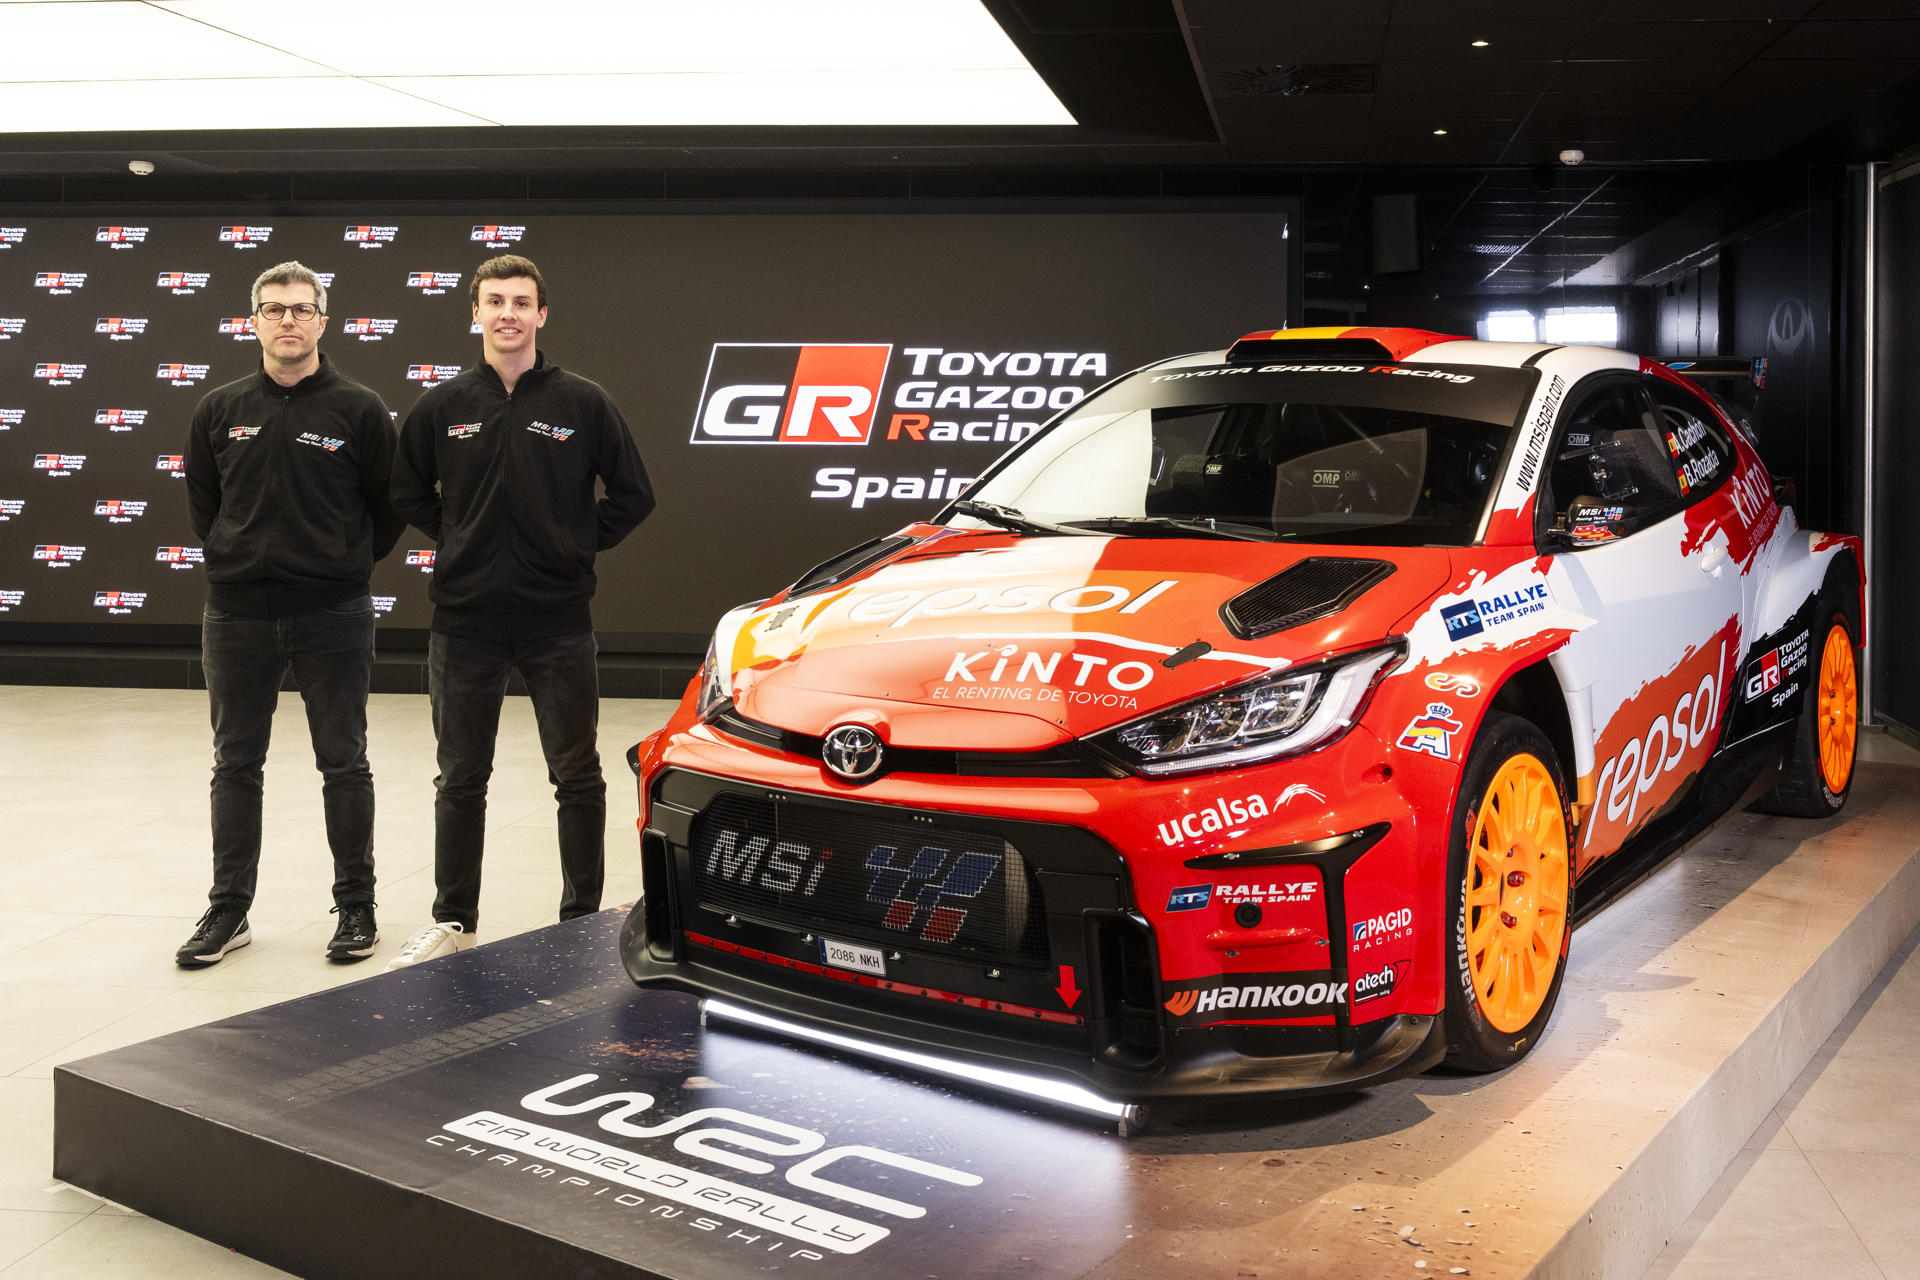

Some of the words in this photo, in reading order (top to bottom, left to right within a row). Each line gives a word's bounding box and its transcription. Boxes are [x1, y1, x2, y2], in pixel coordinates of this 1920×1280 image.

[97, 232, 119, 241] GR
[220, 231, 242, 241] GR
[345, 231, 368, 240] GR
[472, 230, 495, 240] GR
[36, 277, 58, 287] GR
[158, 277, 180, 287] GR
[408, 277, 431, 287] GR
[96, 323, 118, 332] GR
[220, 323, 242, 332] GR
[345, 323, 368, 333] GR
[903, 348, 1107, 377] TOYOTA
[35, 368, 57, 378] GR
[158, 369, 180, 378] GR
[408, 370, 430, 379] GR
[1149, 367, 1253, 383] TOYOTA
[1257, 365, 1365, 373] GAZOO
[1367, 366, 1475, 383] Racing
[894, 381, 1085, 410] GAZOO
[702, 384, 872, 438] GR
[96, 414, 118, 424] GR
[887, 414, 1041, 442] Racin
[1516, 374, 1566, 492] www.msispain.com
[1568, 435, 1590, 444] OMP
[35, 459, 56, 469] GR
[157, 460, 179, 470] GR
[1312, 472, 1340, 484] OMP
[96, 505, 118, 515] GR
[34, 550, 56, 560] GR
[157, 552, 179, 561] GR
[407, 555, 429, 565] GR
[95, 597, 117, 606] GR
[1478, 584, 1548, 616] RALLYE
[1444, 609, 1480, 632] RTS
[1485, 611, 1515, 627] TEAM
[1517, 602, 1545, 617] SPAIN
[1779, 628, 1809, 656] TOYOTA
[1780, 642, 1807, 668] GAZOO
[1781, 654, 1807, 680] Racing
[1747, 664, 1778, 699] GR
[932, 687, 950, 699] EL
[955, 686, 1033, 701] RENTING
[1036, 688, 1063, 702] DE
[1068, 690, 1138, 710] TOYOTA
[1771, 682, 1798, 708] Spain
[1583, 639, 1727, 850] repsol
[1157, 793, 1269, 847] ucalsa
[1215, 881, 1318, 896] RALLYE
[1170, 891, 1208, 905] RTS
[1223, 896, 1263, 904] TEAM
[1267, 894, 1311, 903] SPAIN
[1367, 908, 1412, 937] PAGID
[1353, 928, 1412, 952] RACING
[830, 947, 856, 963] 2086
[860, 953, 880, 968] NKH
[1355, 965, 1394, 992] atech
[464, 1118, 531, 1141] FIA
[533, 1136, 689, 1188] WORLD
[693, 1186, 866, 1242] RALLY
[425, 1134, 823, 1260] CHAMPIONSHIP
